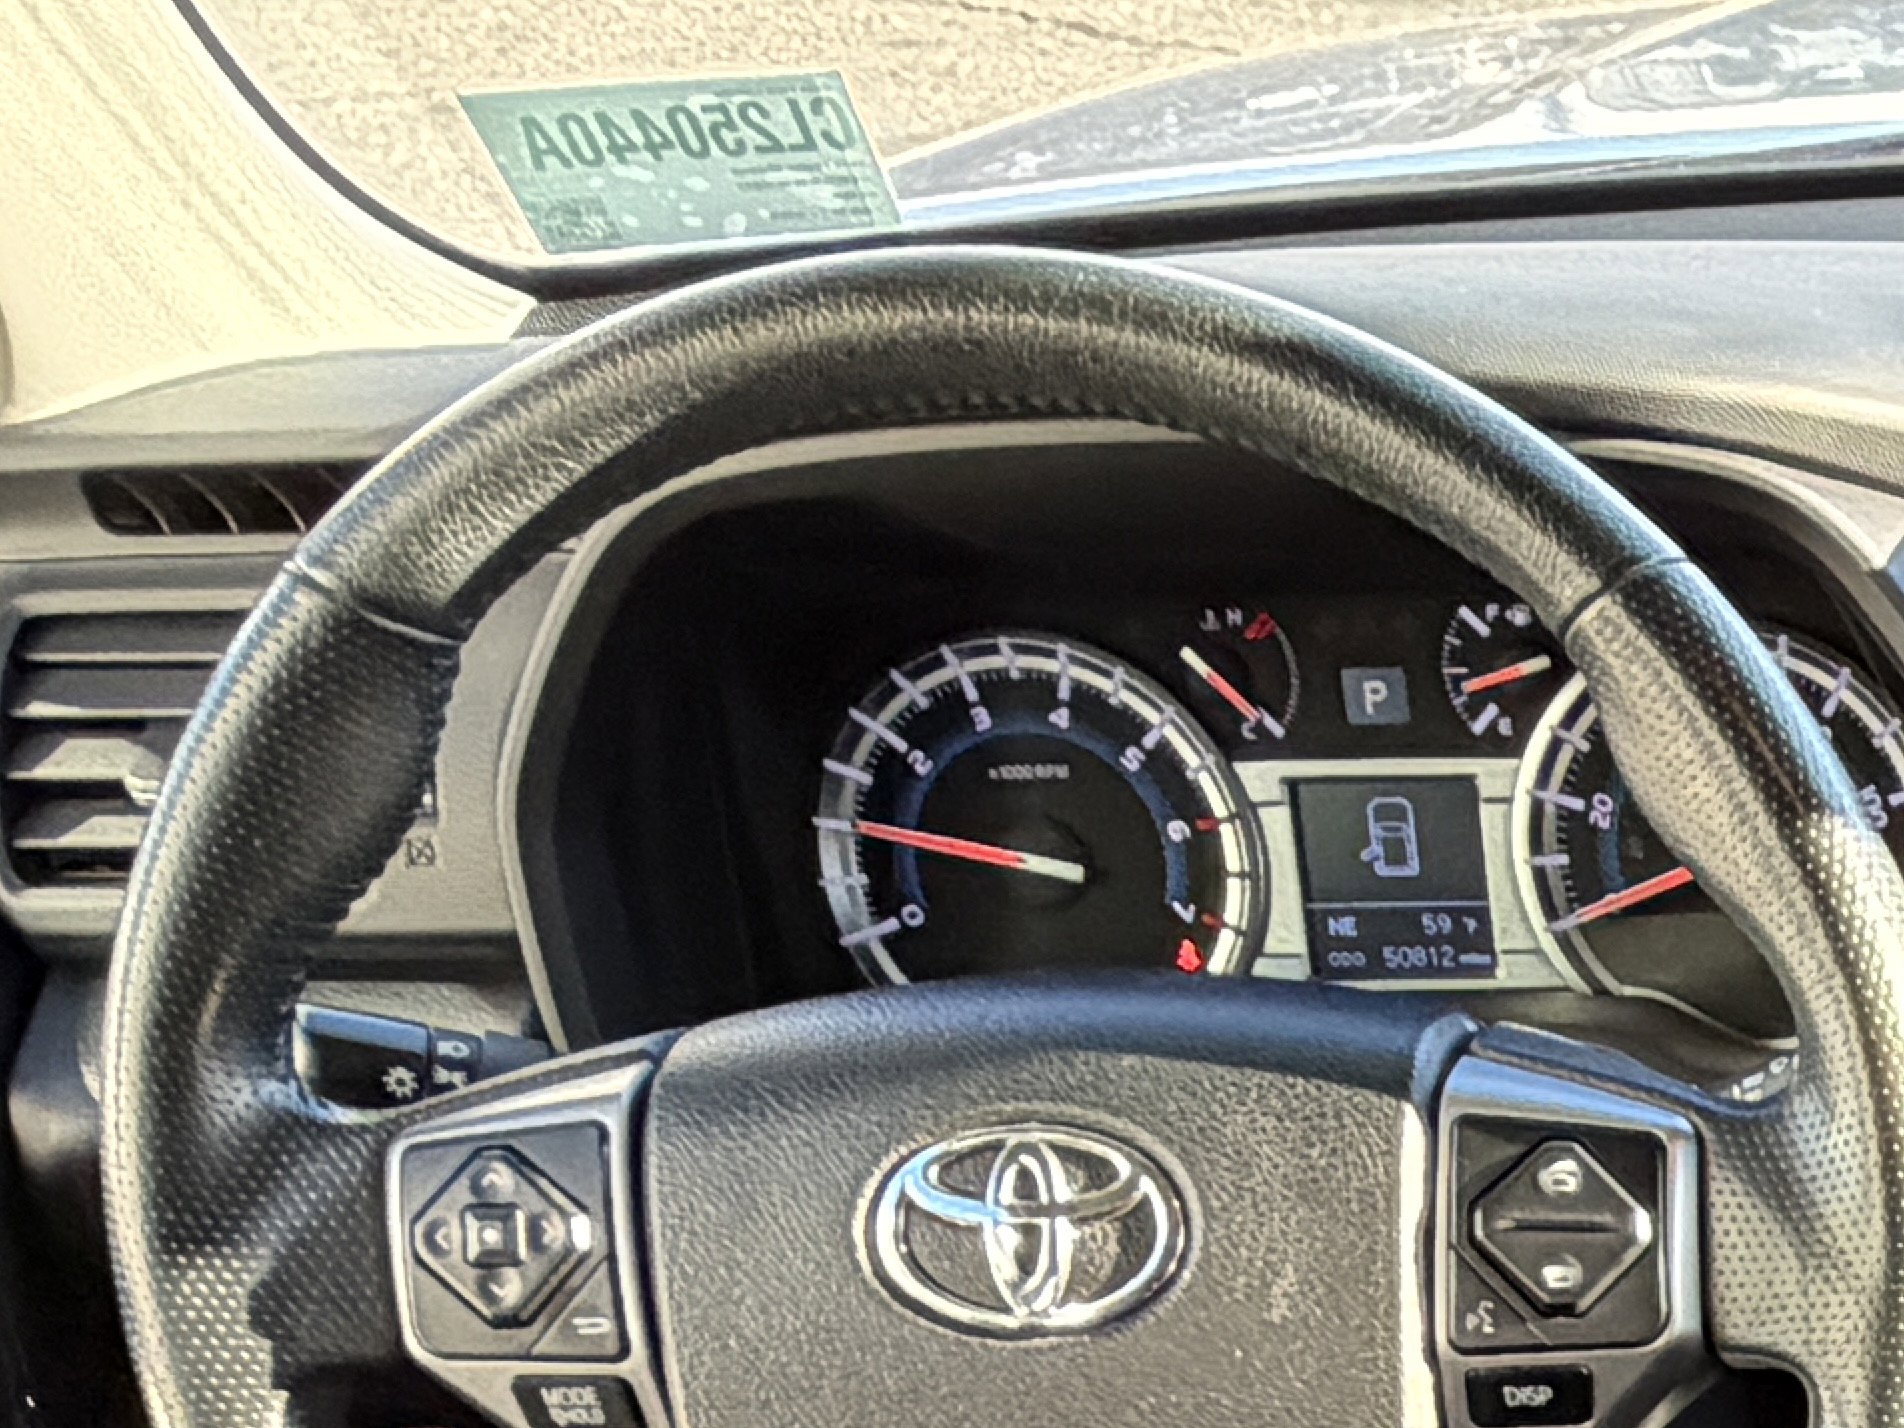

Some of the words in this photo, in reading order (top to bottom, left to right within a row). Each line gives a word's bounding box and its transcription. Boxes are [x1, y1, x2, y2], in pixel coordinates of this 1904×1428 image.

[1362, 681, 1389, 714] P
[970, 706, 993, 732] 3
[1048, 706, 1071, 730] 4
[906, 748, 934, 777] 2
[1119, 747, 1146, 772] 5
[1588, 793, 1615, 830] 20
[1166, 820, 1190, 844] 6
[900, 904, 926, 928] 0
[1171, 900, 1197, 924] 7
[1382, 944, 1456, 969] 50812
[540, 1385, 597, 1408] MODE
[1503, 1385, 1554, 1408] DISP
